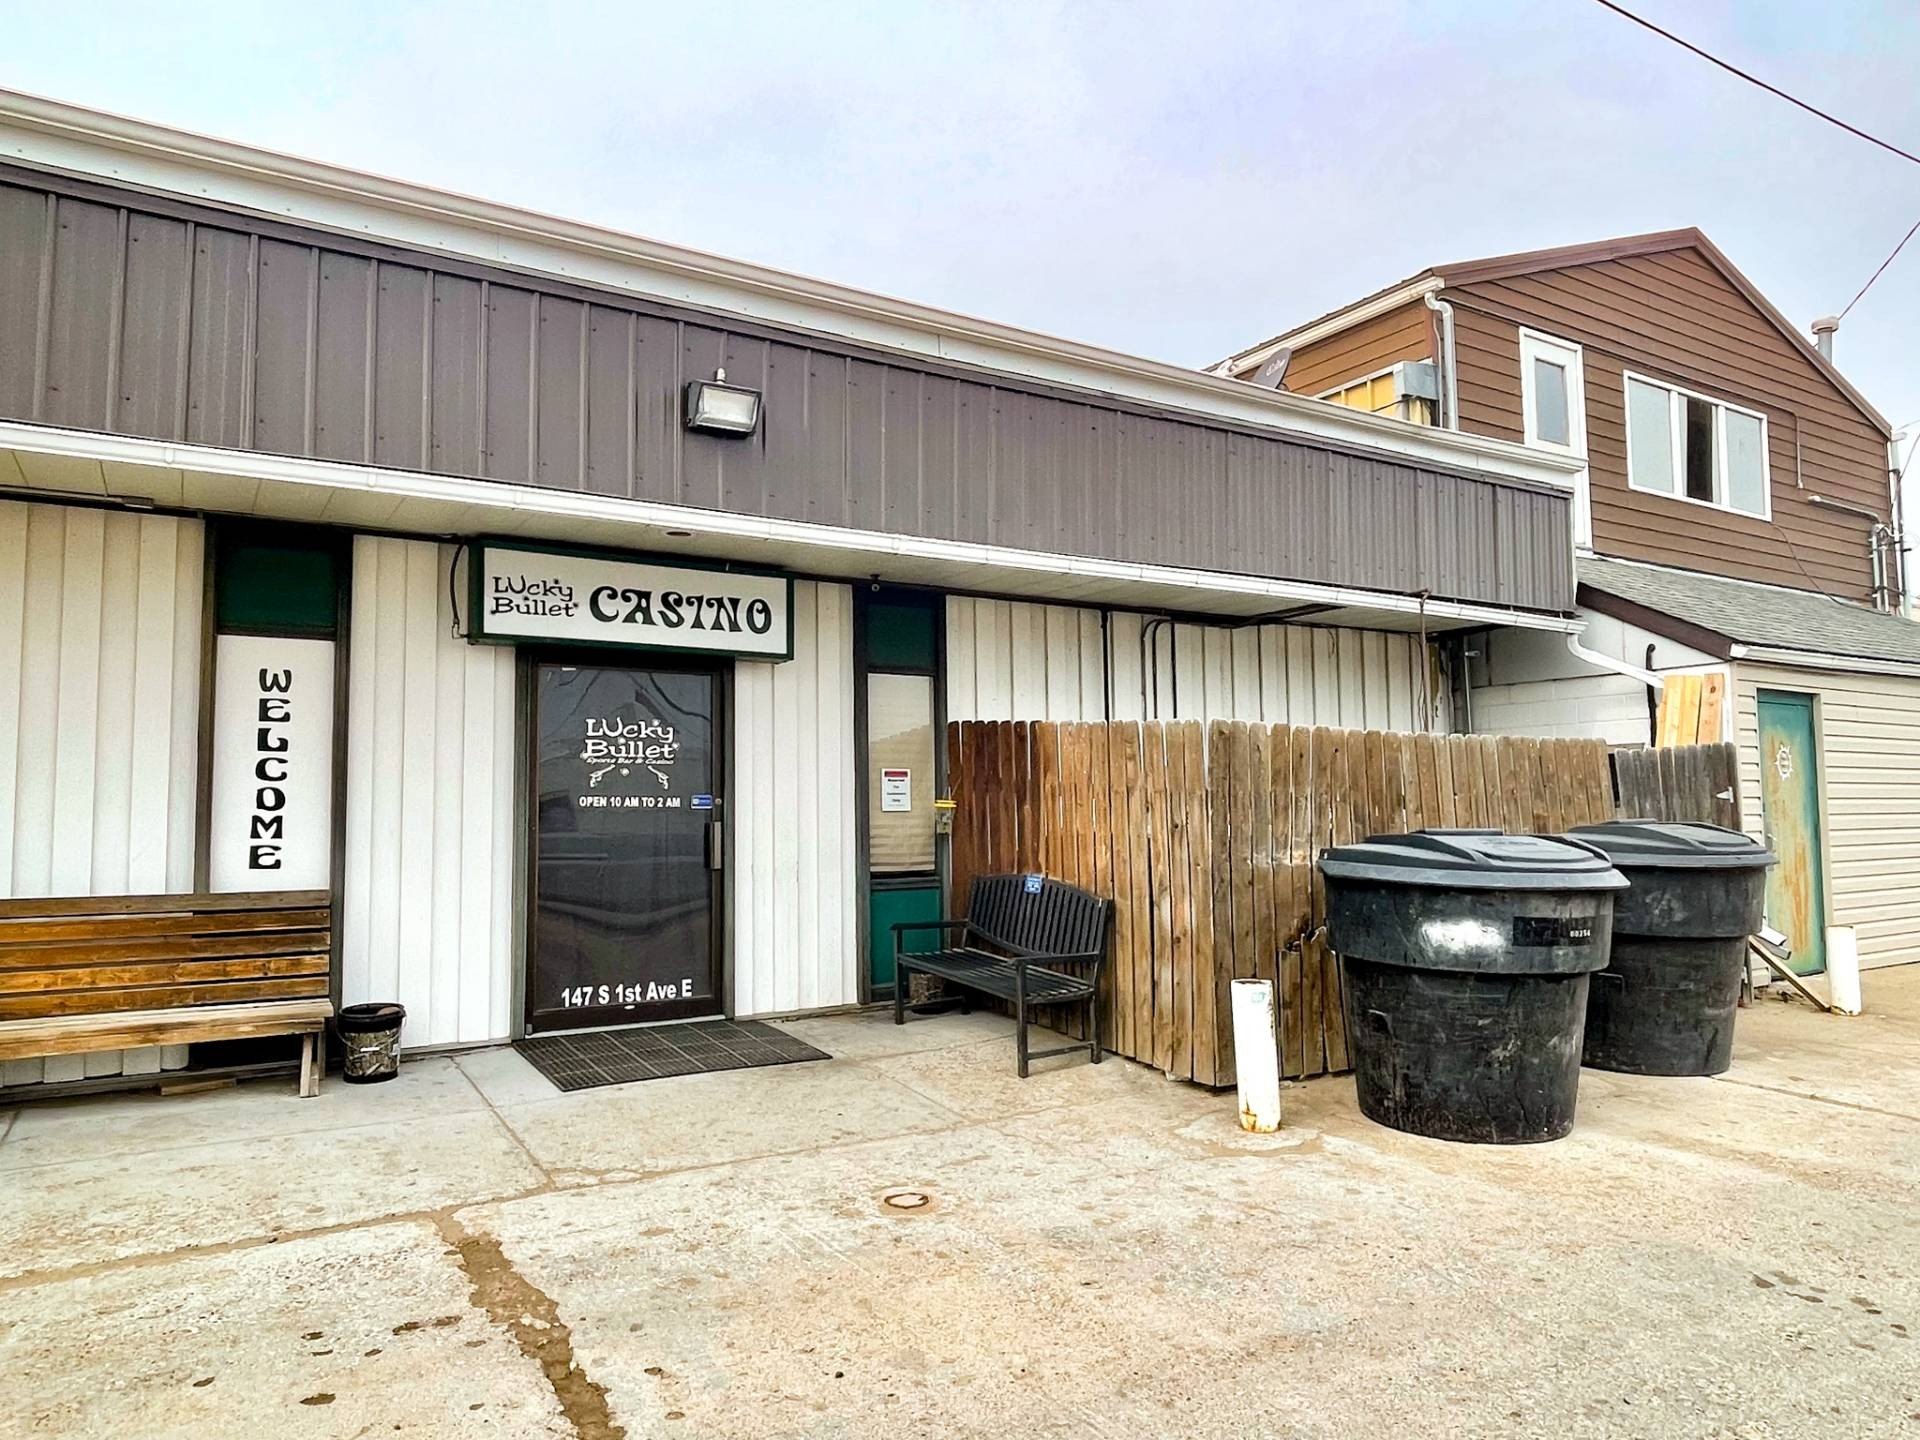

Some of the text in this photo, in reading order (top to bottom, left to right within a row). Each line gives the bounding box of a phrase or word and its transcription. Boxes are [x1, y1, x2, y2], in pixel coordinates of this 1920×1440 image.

[491, 597, 576, 618] Bullet
[589, 585, 772, 634] CASINO
[584, 739, 675, 758] Bullet
[249, 668, 292, 869] WELCOME
[579, 796, 607, 807] OPEN
[609, 796, 621, 807] 10
[623, 797, 640, 807] AM
[641, 797, 655, 807] TO
[657, 797, 664, 807] 2
[665, 797, 680, 807] AM
[561, 979, 693, 1008] 147 S 1st Ave E
